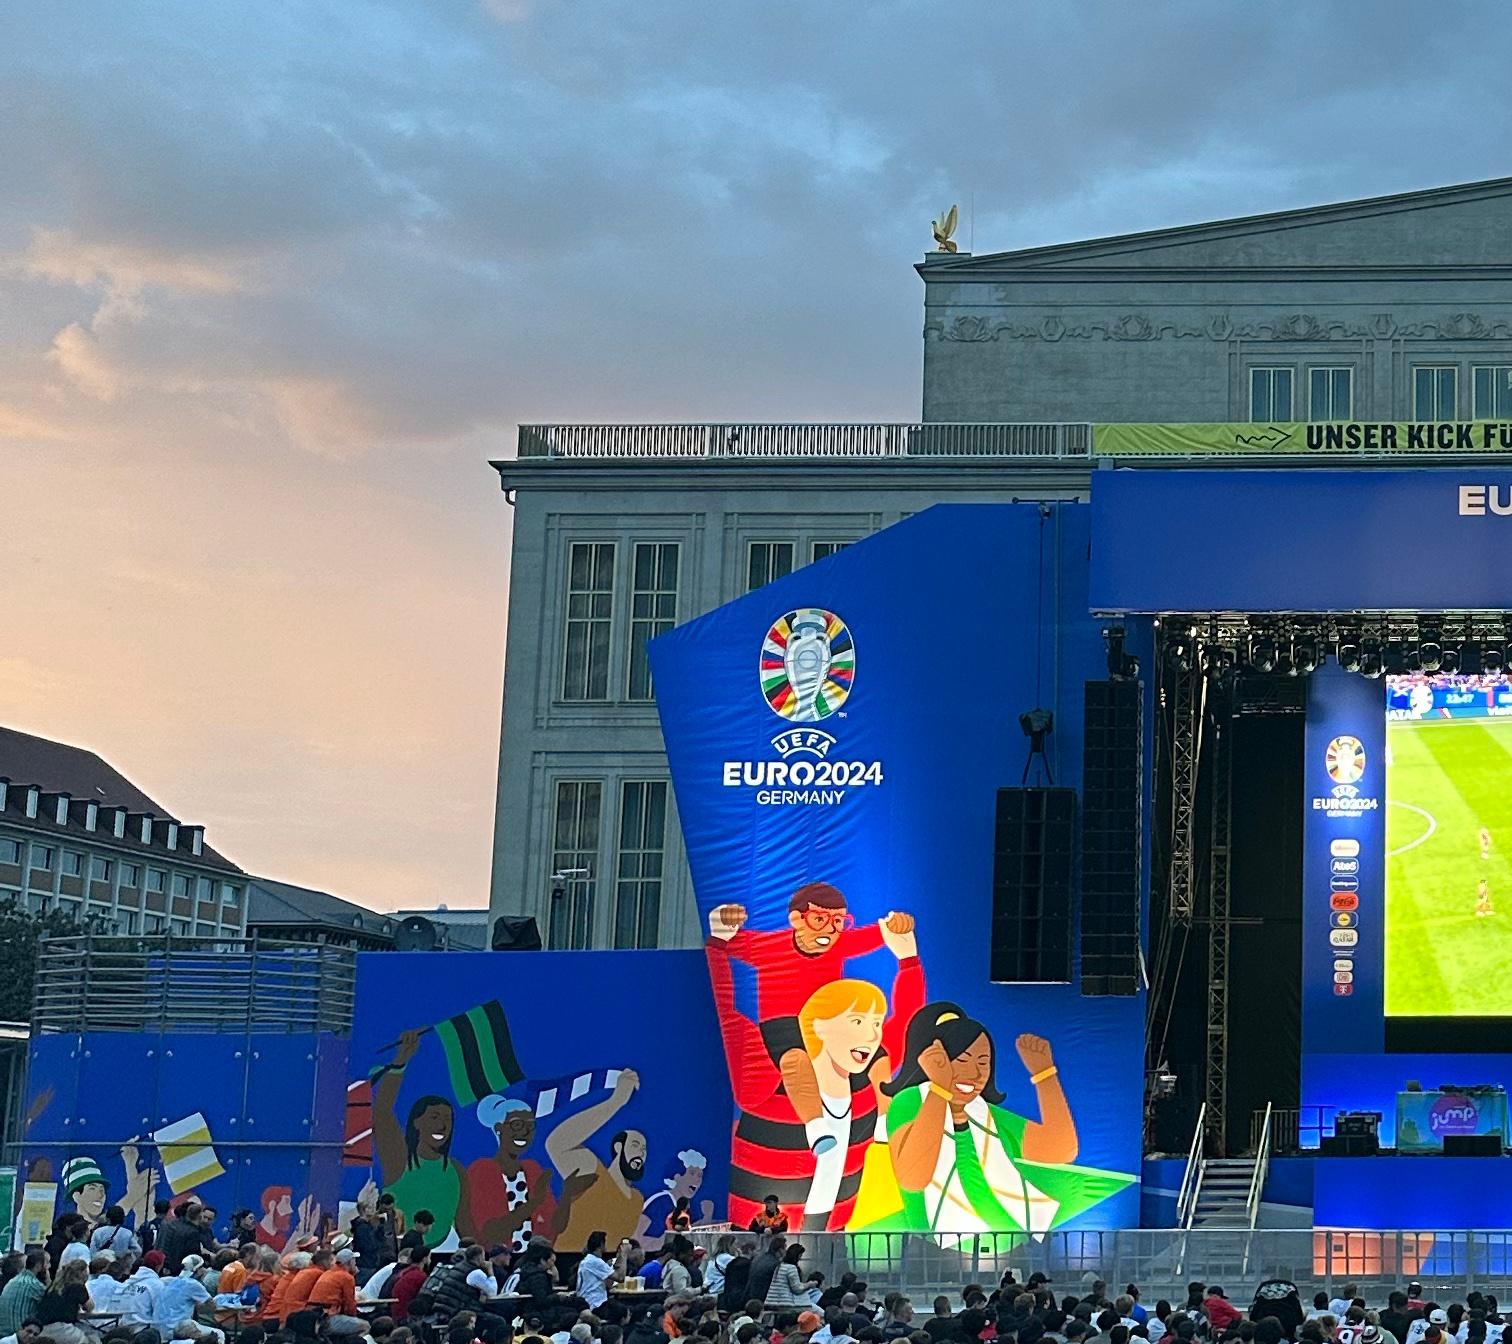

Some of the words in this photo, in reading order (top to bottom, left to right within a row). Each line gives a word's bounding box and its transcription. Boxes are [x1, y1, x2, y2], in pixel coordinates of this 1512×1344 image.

[1306, 423, 1398, 450] UNSER
[1407, 423, 1473, 450] KICK
[774, 733, 831, 755] UEFA
[723, 761, 884, 786] EURO2024
[756, 790, 846, 805] GERMANY
[1432, 1106, 1475, 1131] jump
